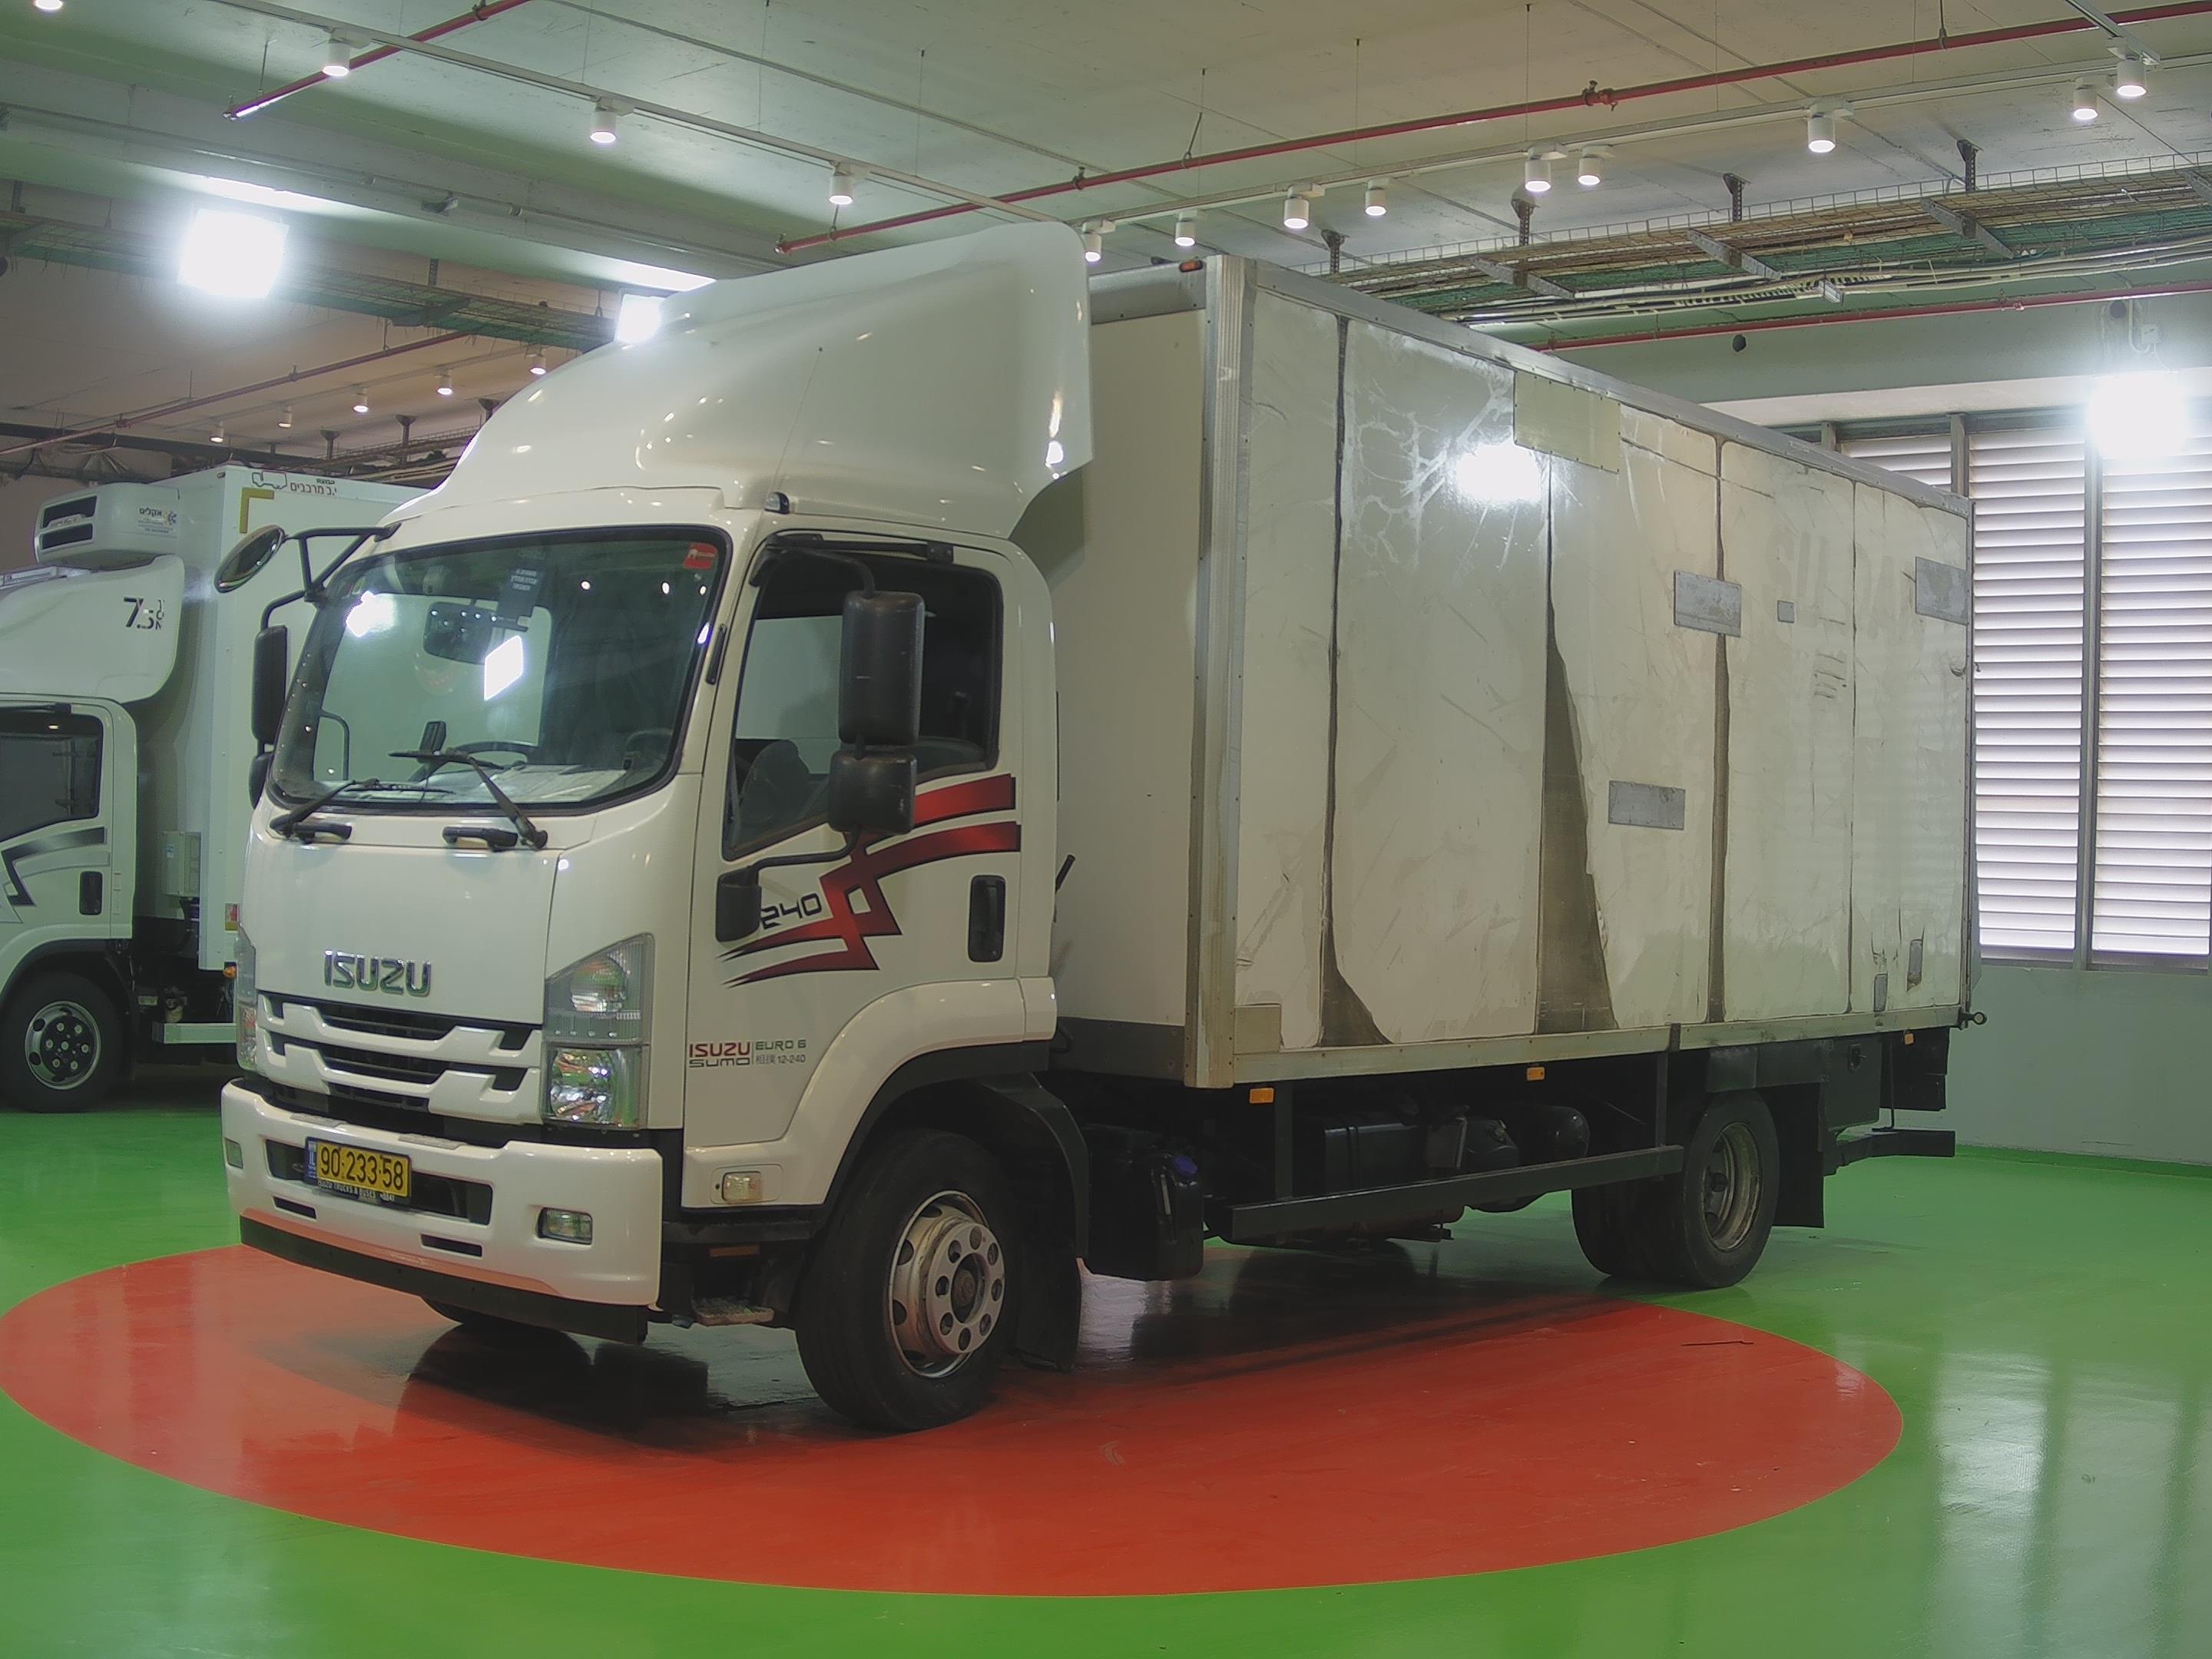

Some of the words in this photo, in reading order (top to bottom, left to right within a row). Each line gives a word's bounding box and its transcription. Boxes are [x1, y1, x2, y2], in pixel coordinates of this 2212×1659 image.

[760, 893, 823, 930] 240
[324, 950, 432, 997] ISUZU
[689, 1041, 750, 1058] ISUZU
[756, 1041, 794, 1051] EURO
[797, 1040, 806, 1048] 6
